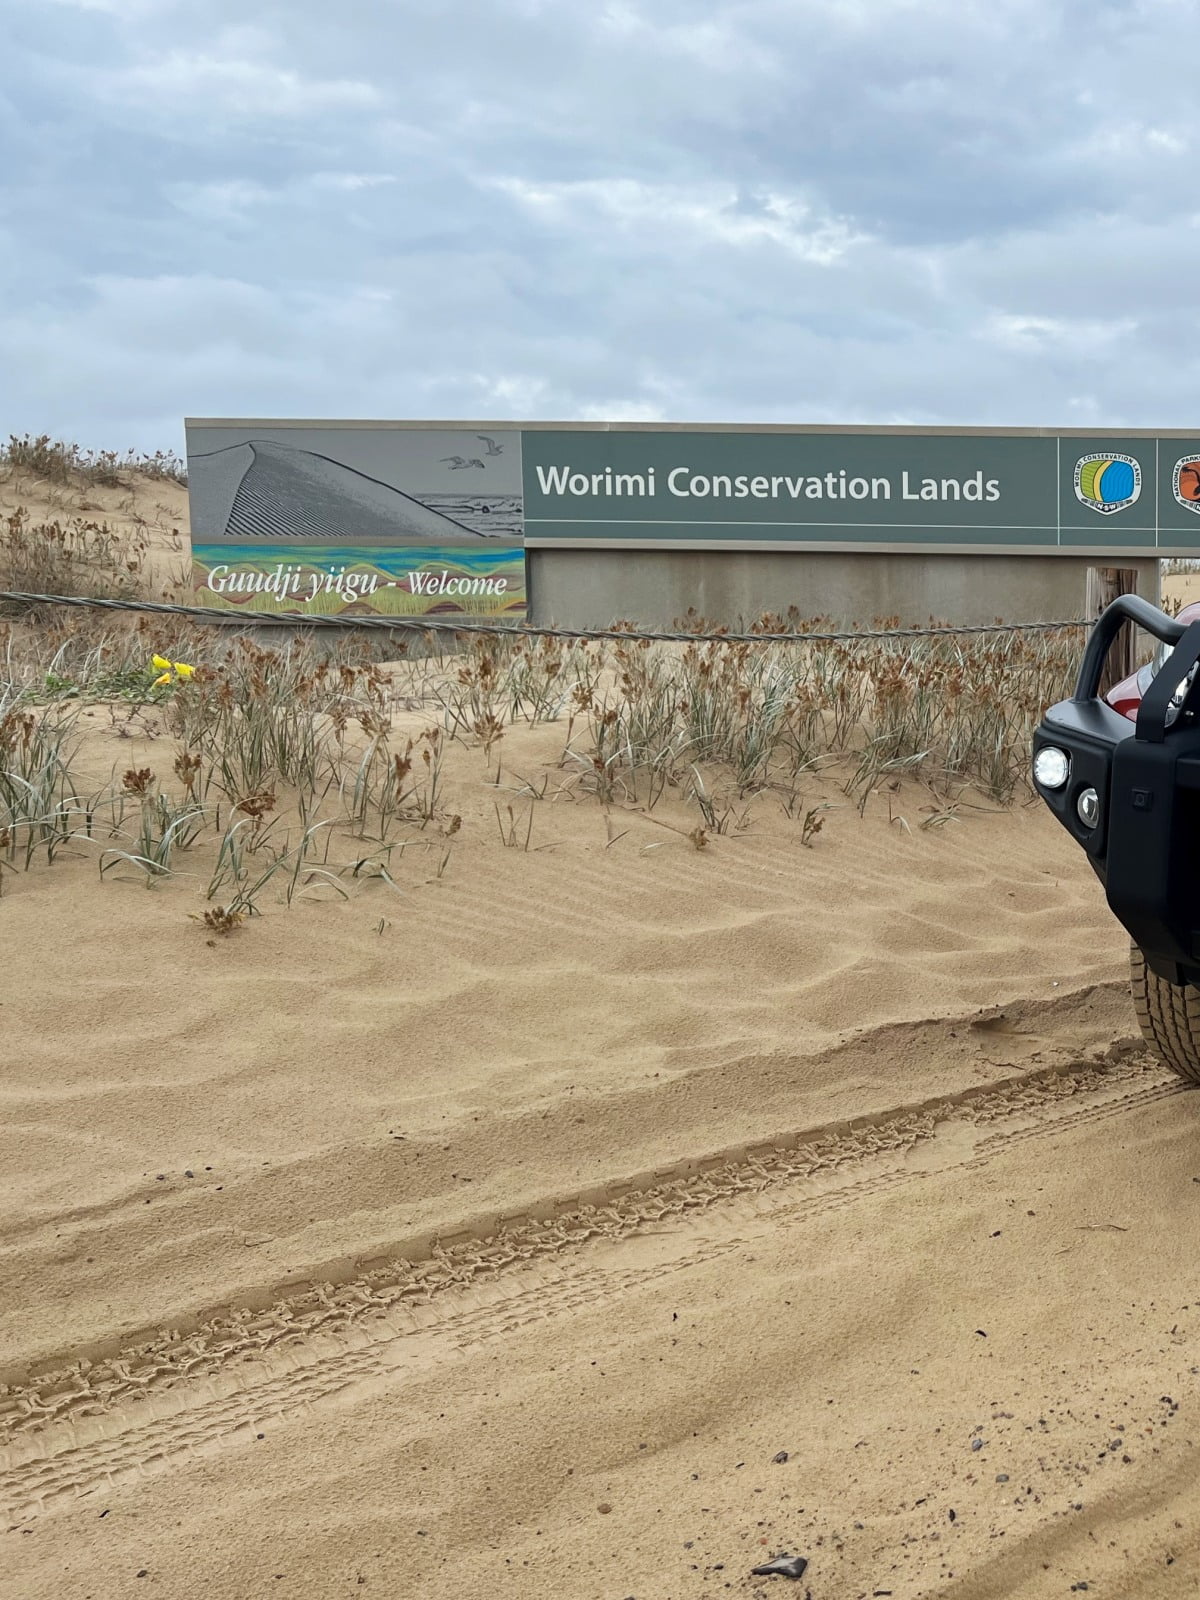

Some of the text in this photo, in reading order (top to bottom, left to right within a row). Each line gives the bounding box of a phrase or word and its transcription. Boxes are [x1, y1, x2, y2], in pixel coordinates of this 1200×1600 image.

[535, 465, 1001, 502] Worimi Conservation Lands
[1075, 454, 1141, 487] WORIMI CONSERVATION LANDS
[1173, 464, 1182, 497] NATIONAL
[206, 564, 304, 602] Guudji
[305, 566, 378, 602] yiigu
[407, 569, 508, 596] Welcome
